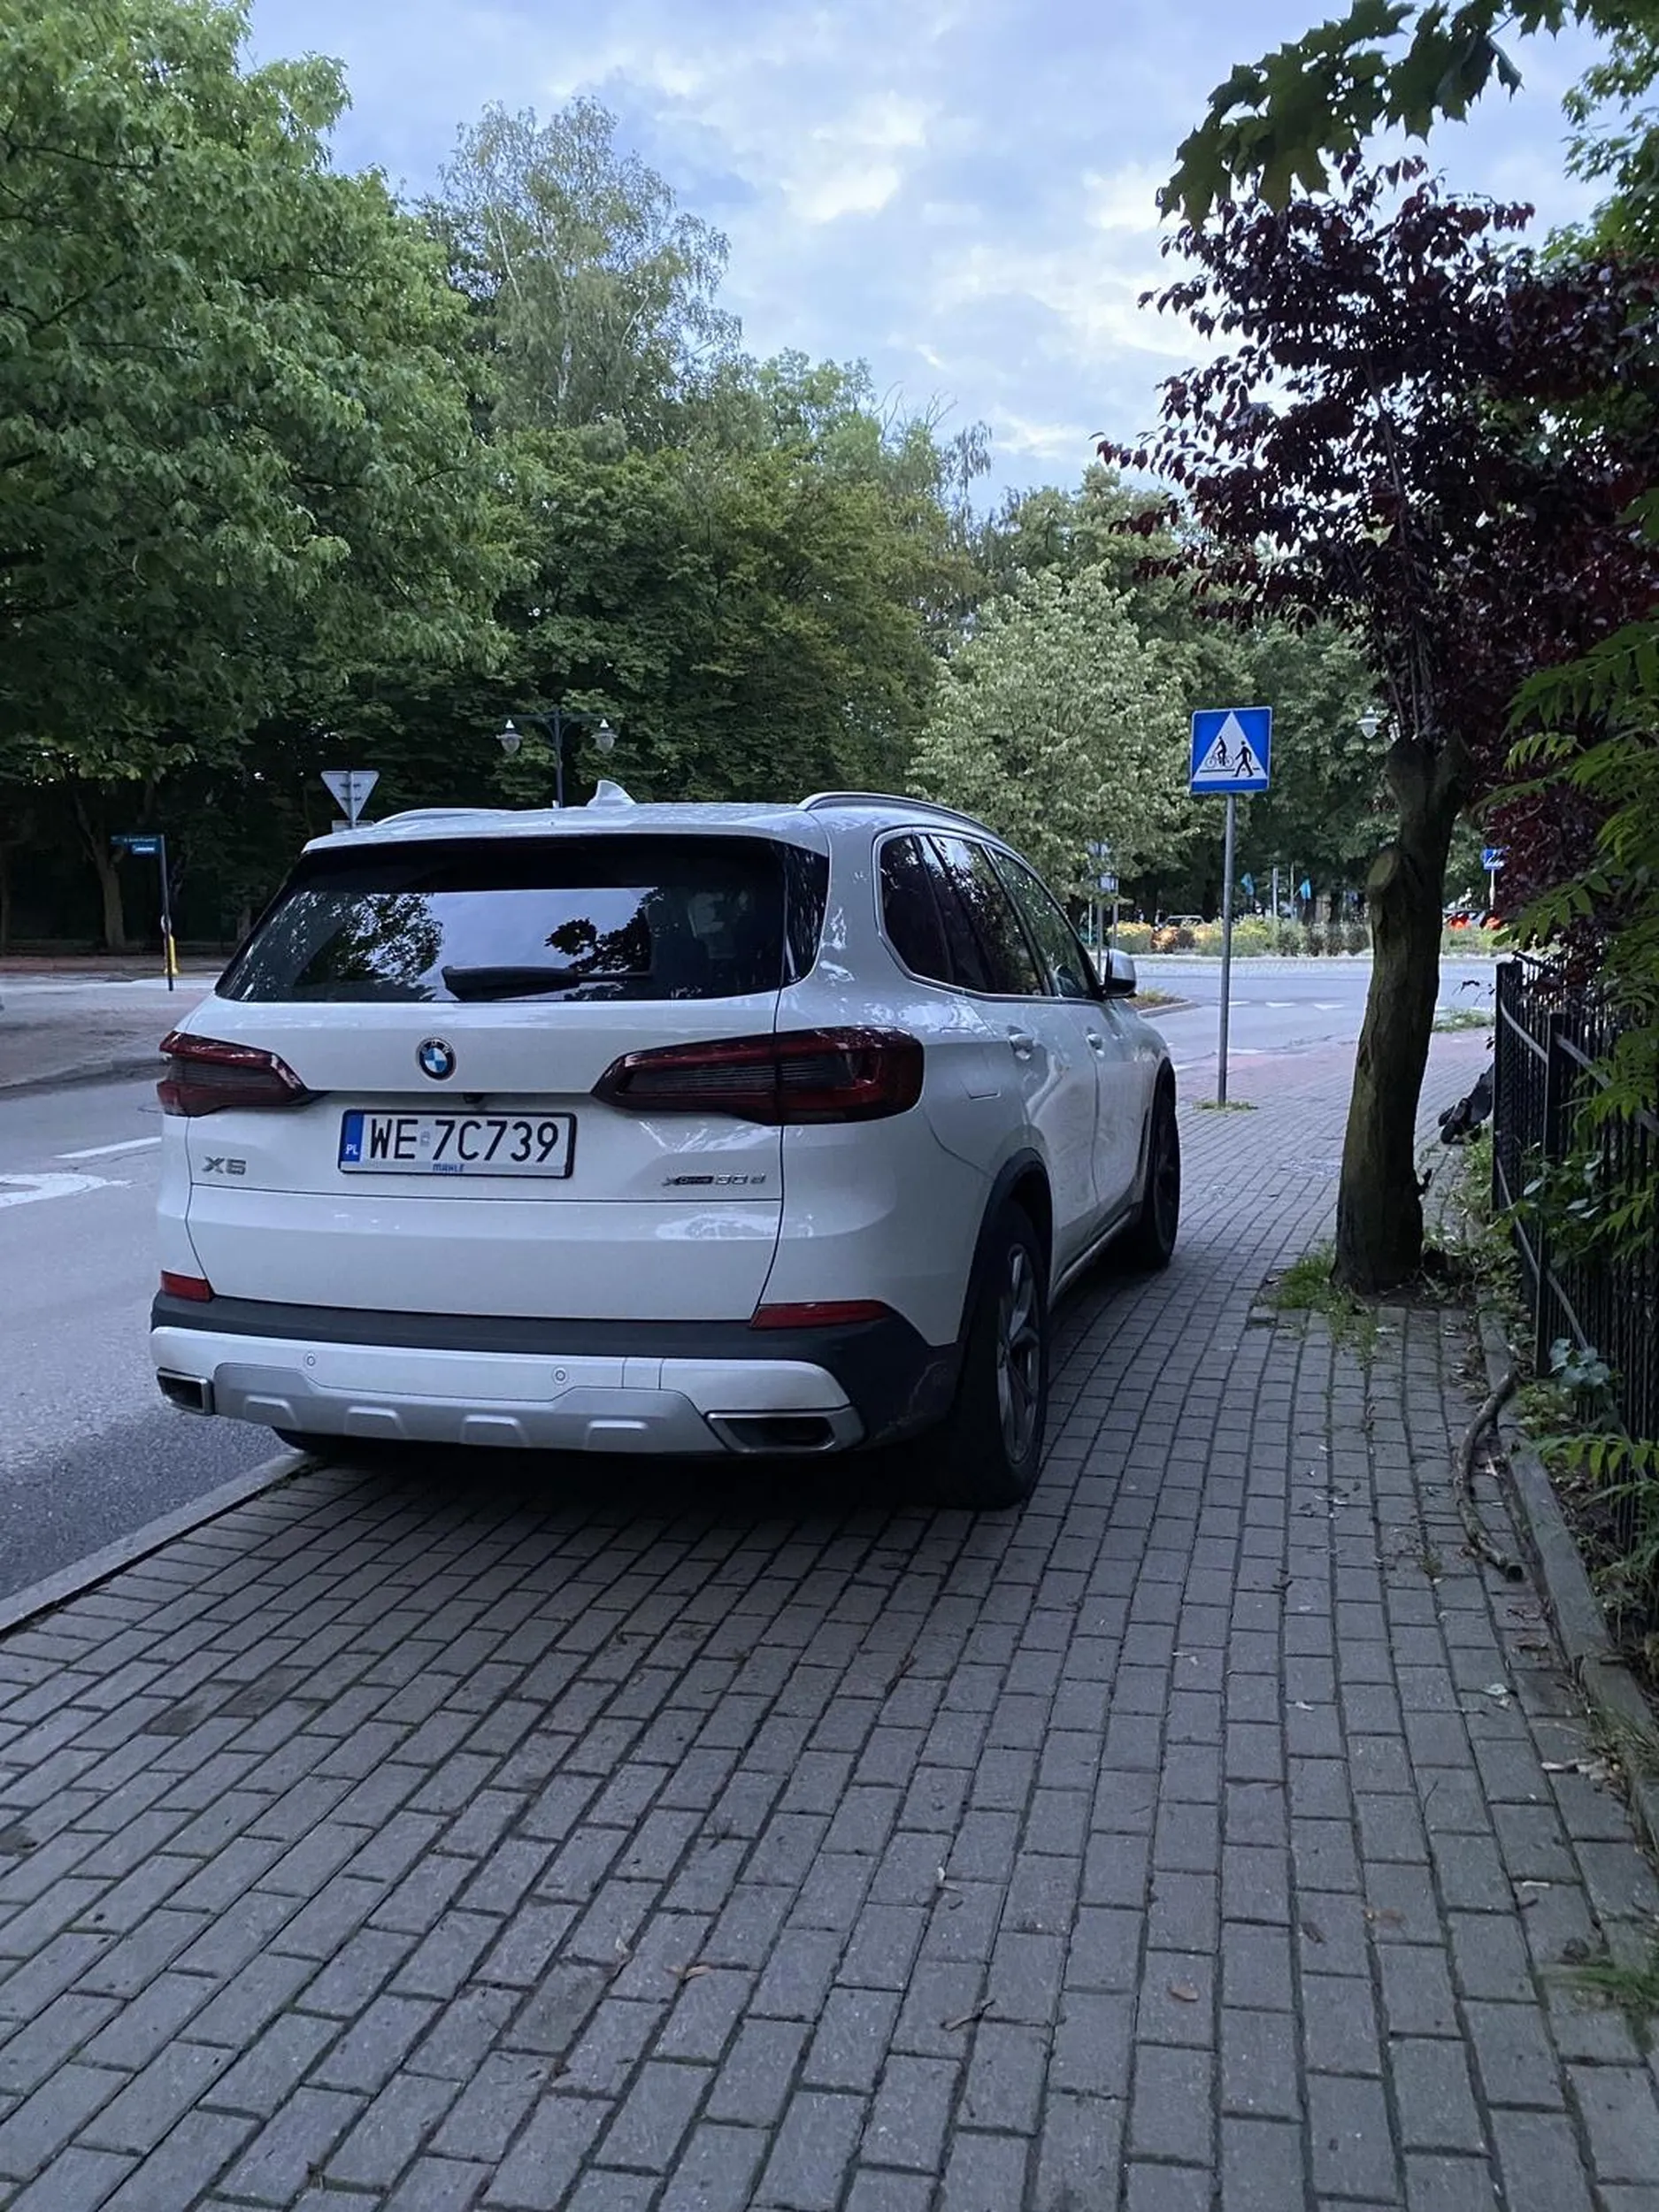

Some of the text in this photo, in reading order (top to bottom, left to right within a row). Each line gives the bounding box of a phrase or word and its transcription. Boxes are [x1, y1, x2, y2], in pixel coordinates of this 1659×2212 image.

[346, 1144, 358, 1155] PL
[370, 1118, 559, 1163] WE 7C739
